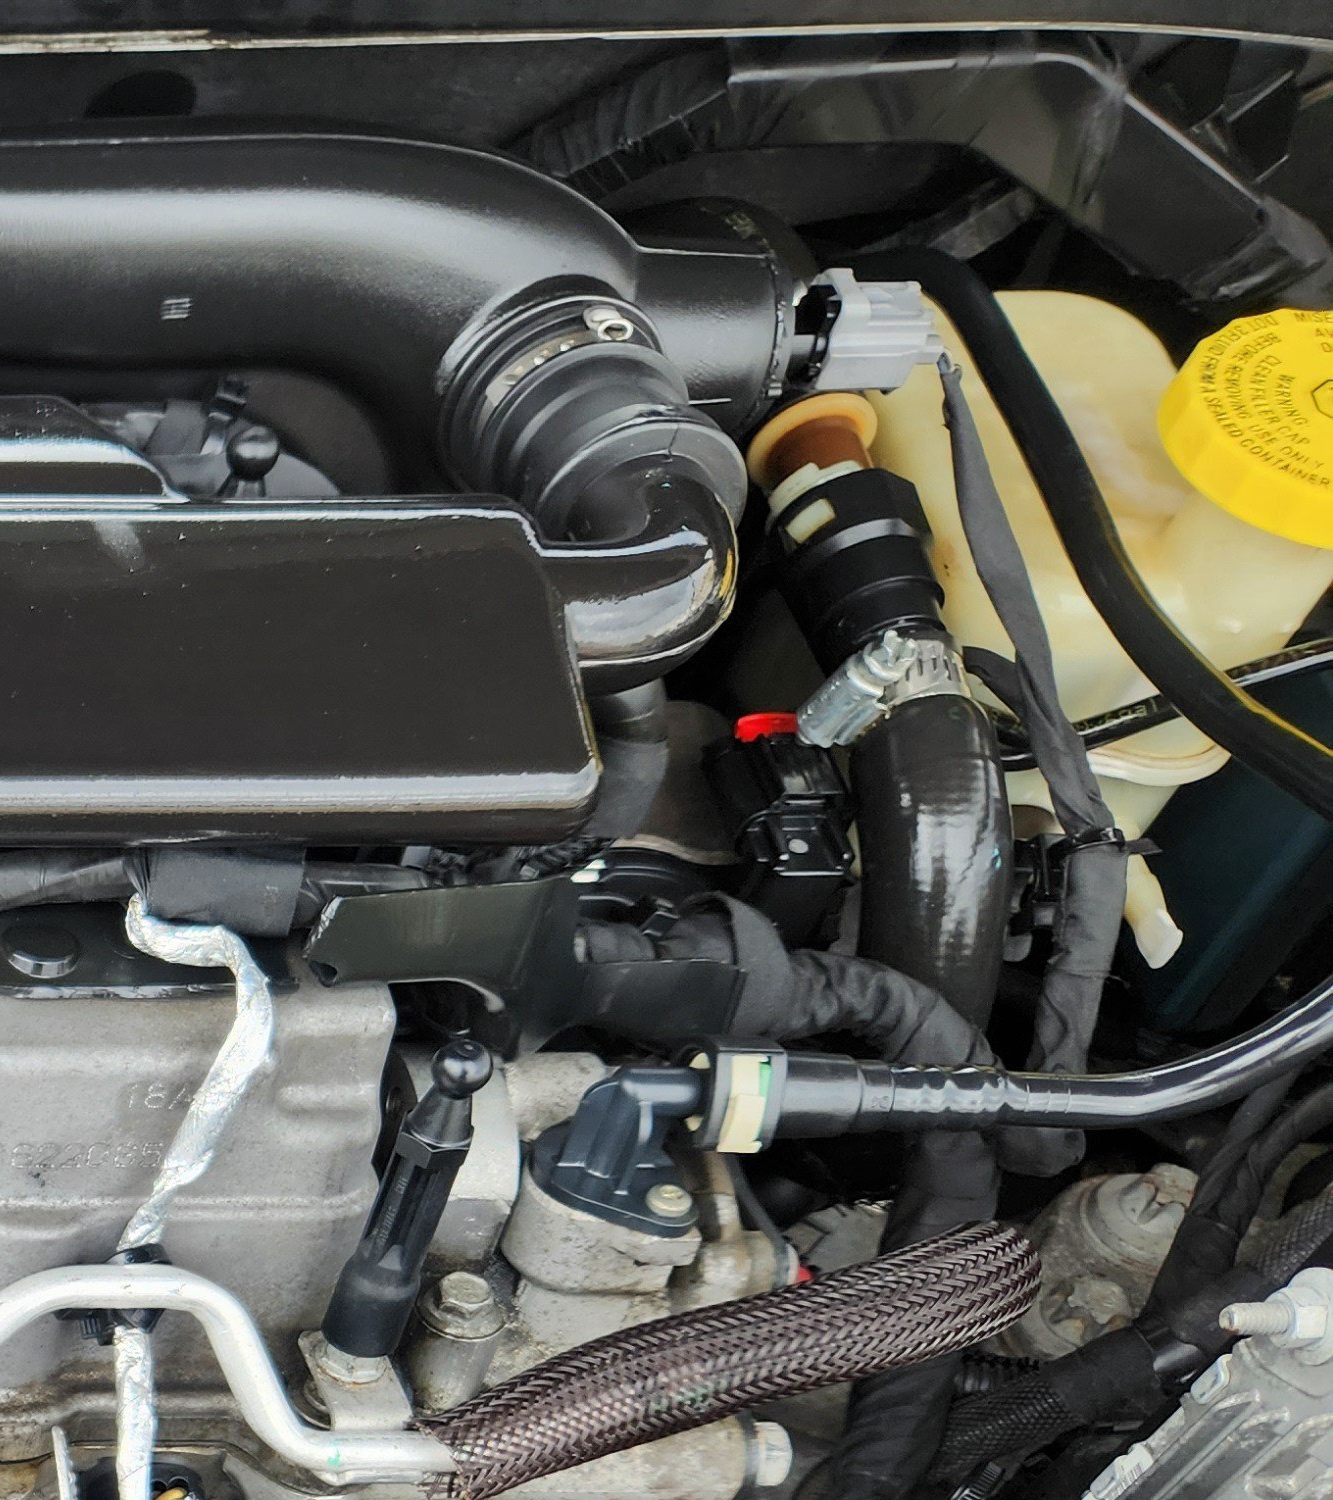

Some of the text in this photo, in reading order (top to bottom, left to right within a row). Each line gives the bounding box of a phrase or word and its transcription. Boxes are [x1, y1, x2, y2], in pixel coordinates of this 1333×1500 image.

[1275, 373, 1309, 426] WARNING
[1203, 396, 1243, 438] SEALED
[1240, 438, 1331, 488] CONTAINER
[1249, 422, 1278, 446] USE
[1279, 446, 1325, 469] ONLY
[1276, 425, 1311, 446] CAP
